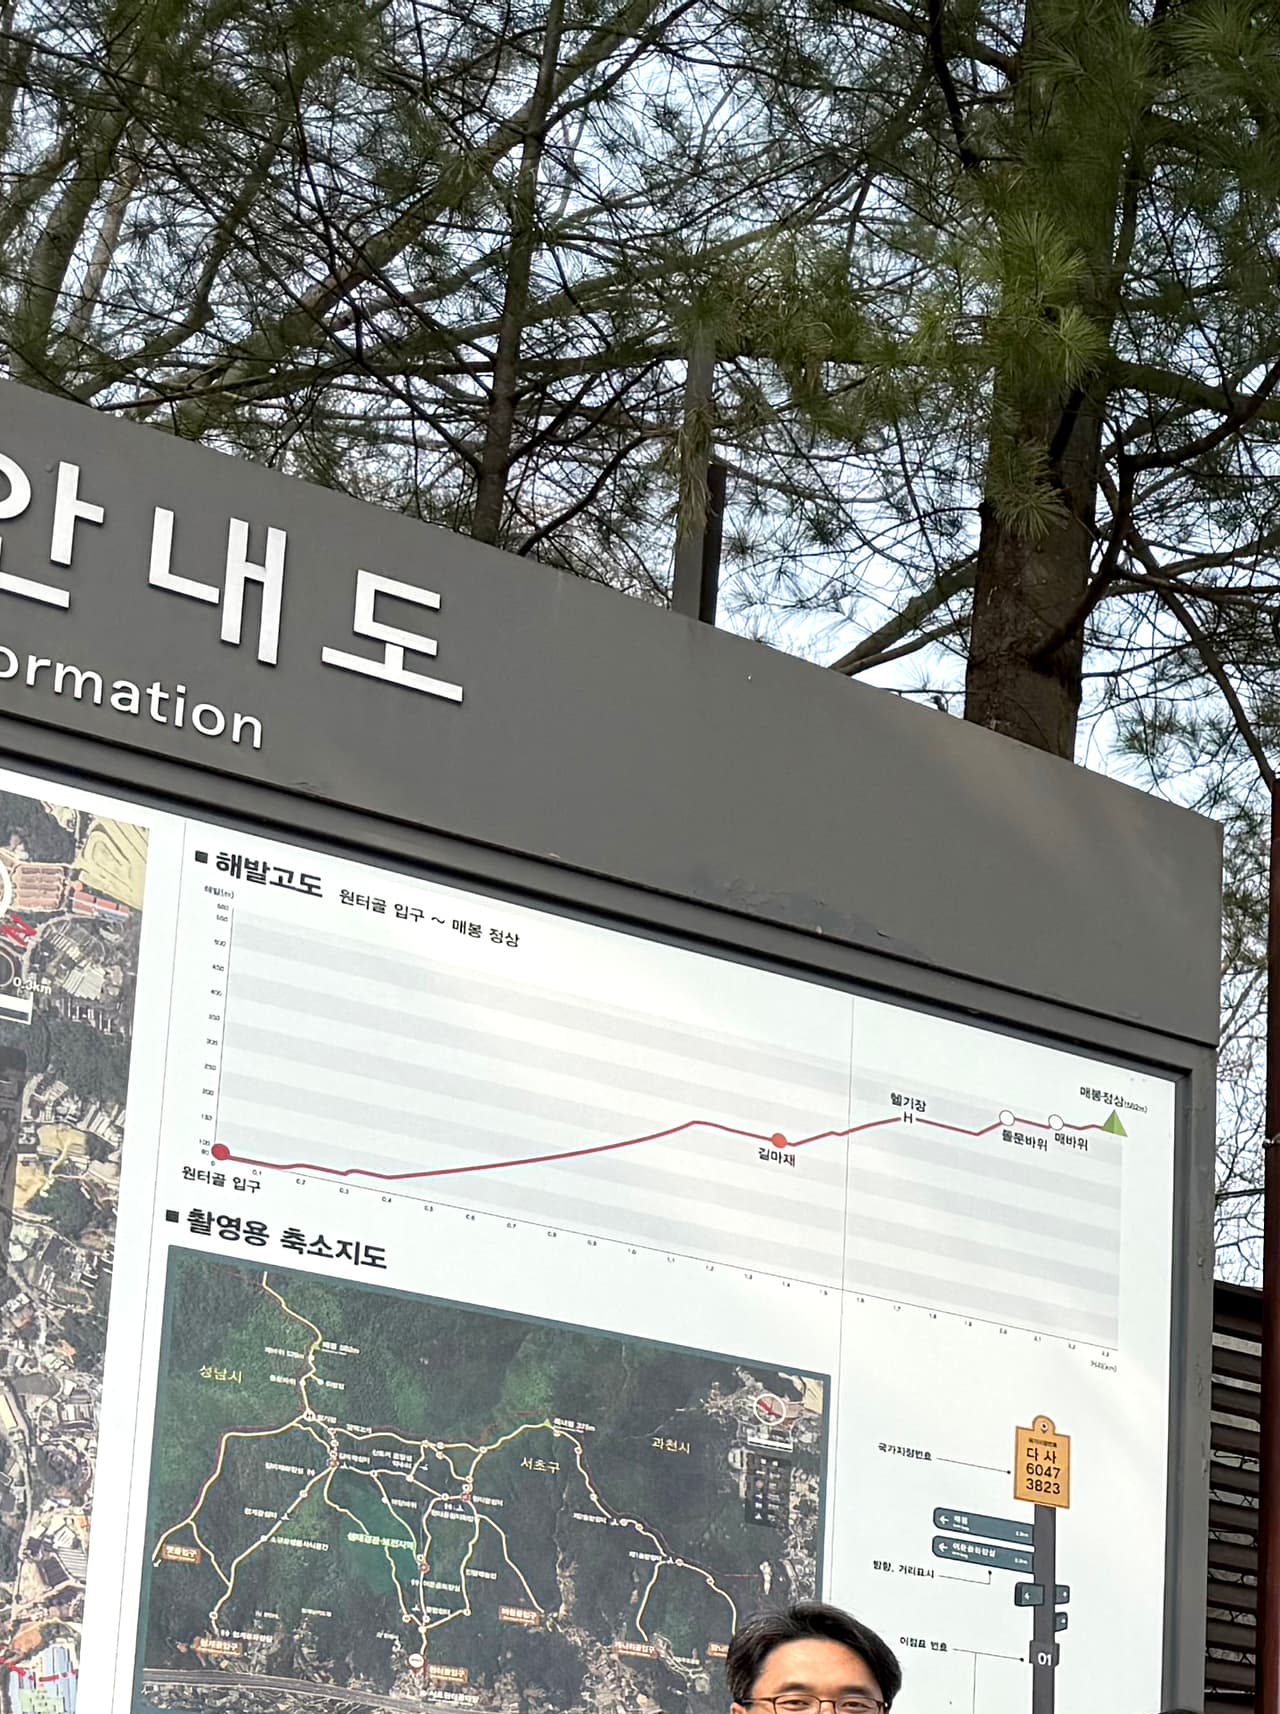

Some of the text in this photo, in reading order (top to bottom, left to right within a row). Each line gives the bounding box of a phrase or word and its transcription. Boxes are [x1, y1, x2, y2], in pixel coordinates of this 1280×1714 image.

[216, 852, 323, 898] 해발고도
[339, 889, 387, 914] 원터골
[394, 903, 425, 923] 입구
[452, 918, 483, 939] 매봉
[489, 926, 521, 948] 정상
[13, 976, 52, 995] 0.3km
[890, 1092, 927, 1113] 헬기장
[182, 1165, 261, 1194] 원터골 입구
[187, 1208, 388, 1269] 촬영용 축소지도
[200, 1364, 242, 1384] 성남시
[652, 1437, 691, 1455] 과천시
[520, 1457, 561, 1474] 서초구
[1026, 1463, 1061, 1479] 6047
[1026, 1478, 1060, 1495] 3823
[1037, 1652, 1053, 1666] 01
